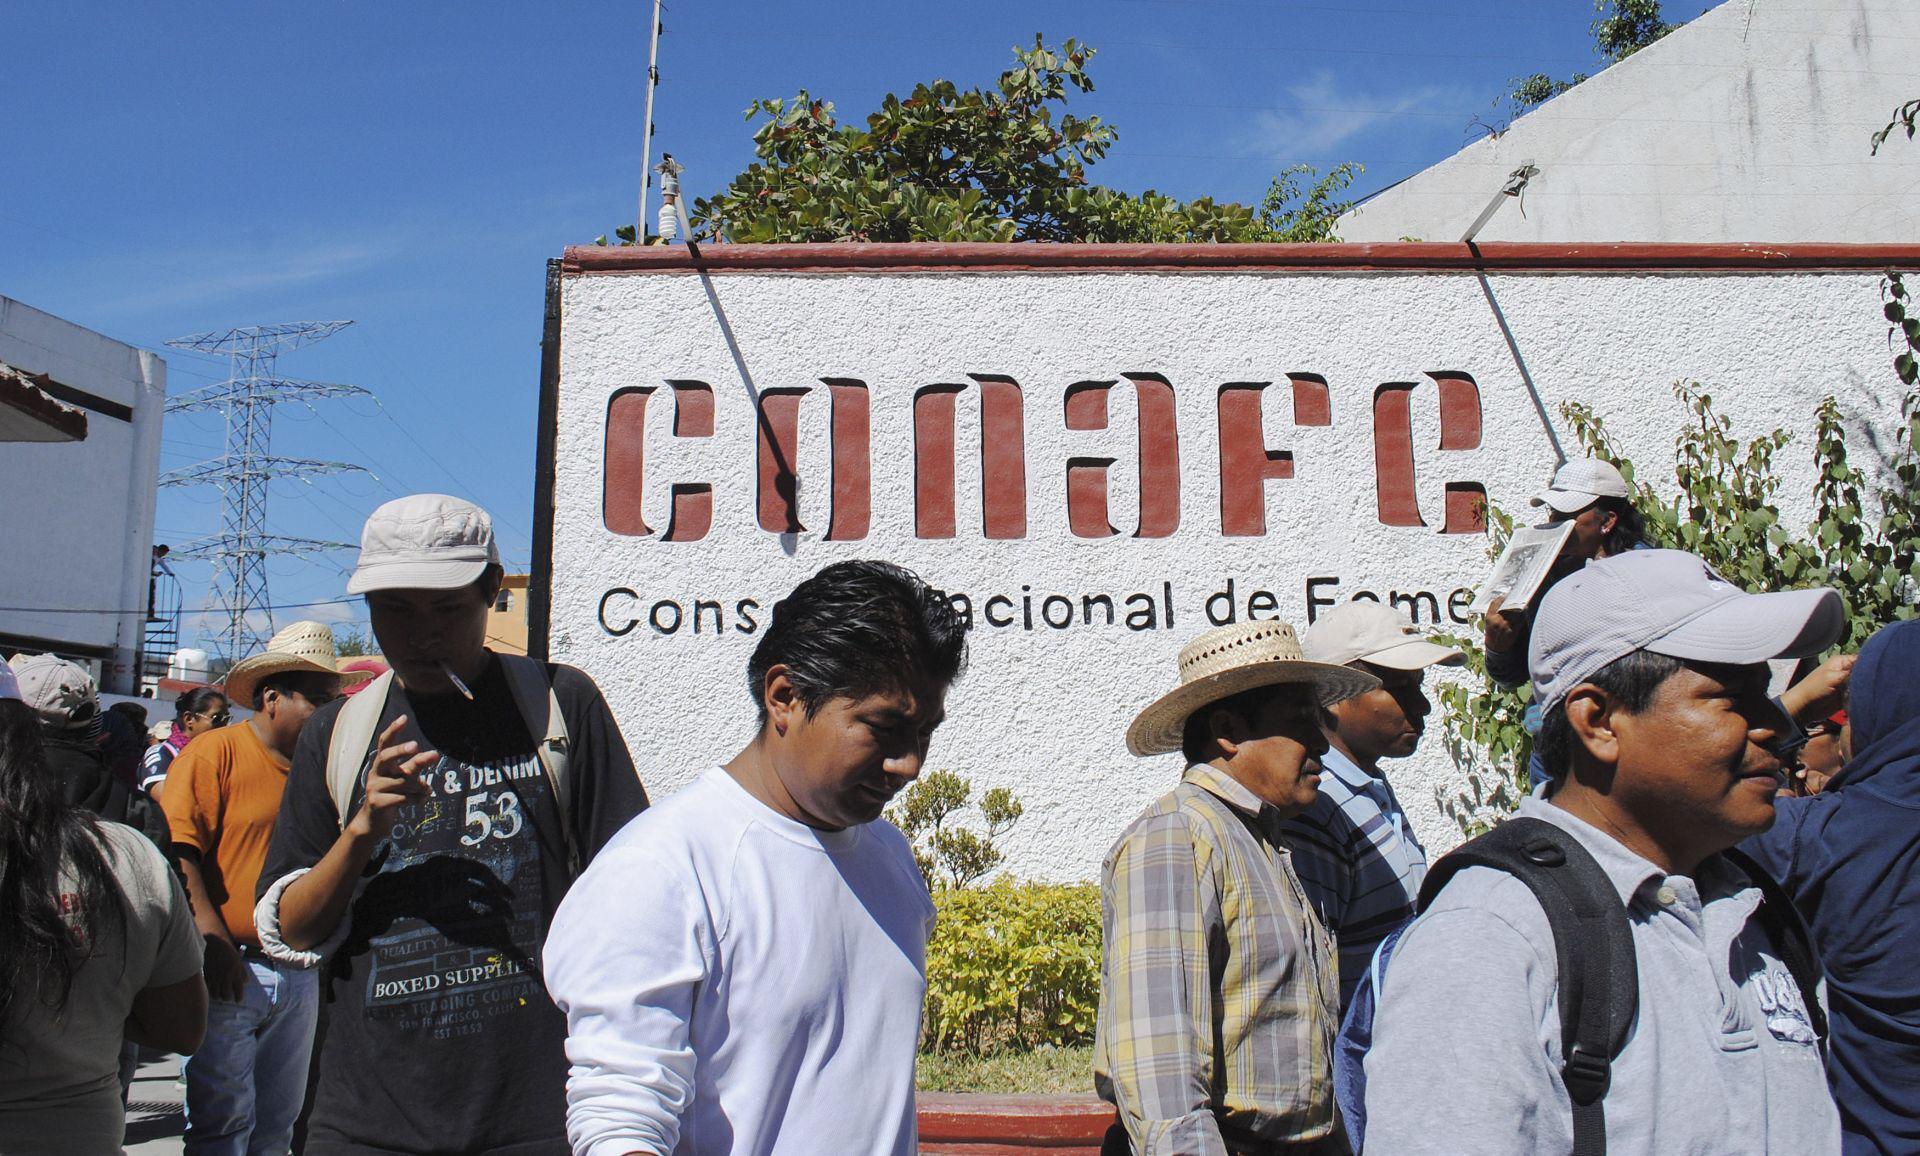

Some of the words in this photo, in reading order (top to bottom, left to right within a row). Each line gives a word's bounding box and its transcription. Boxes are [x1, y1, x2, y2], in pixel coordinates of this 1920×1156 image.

[598, 586, 760, 637] Cons
[944, 580, 1174, 632] acional
[1205, 578, 1280, 627] de
[461, 791, 522, 845] 53
[375, 974, 440, 998] BOXED
[445, 957, 536, 986] SUPPLIES
